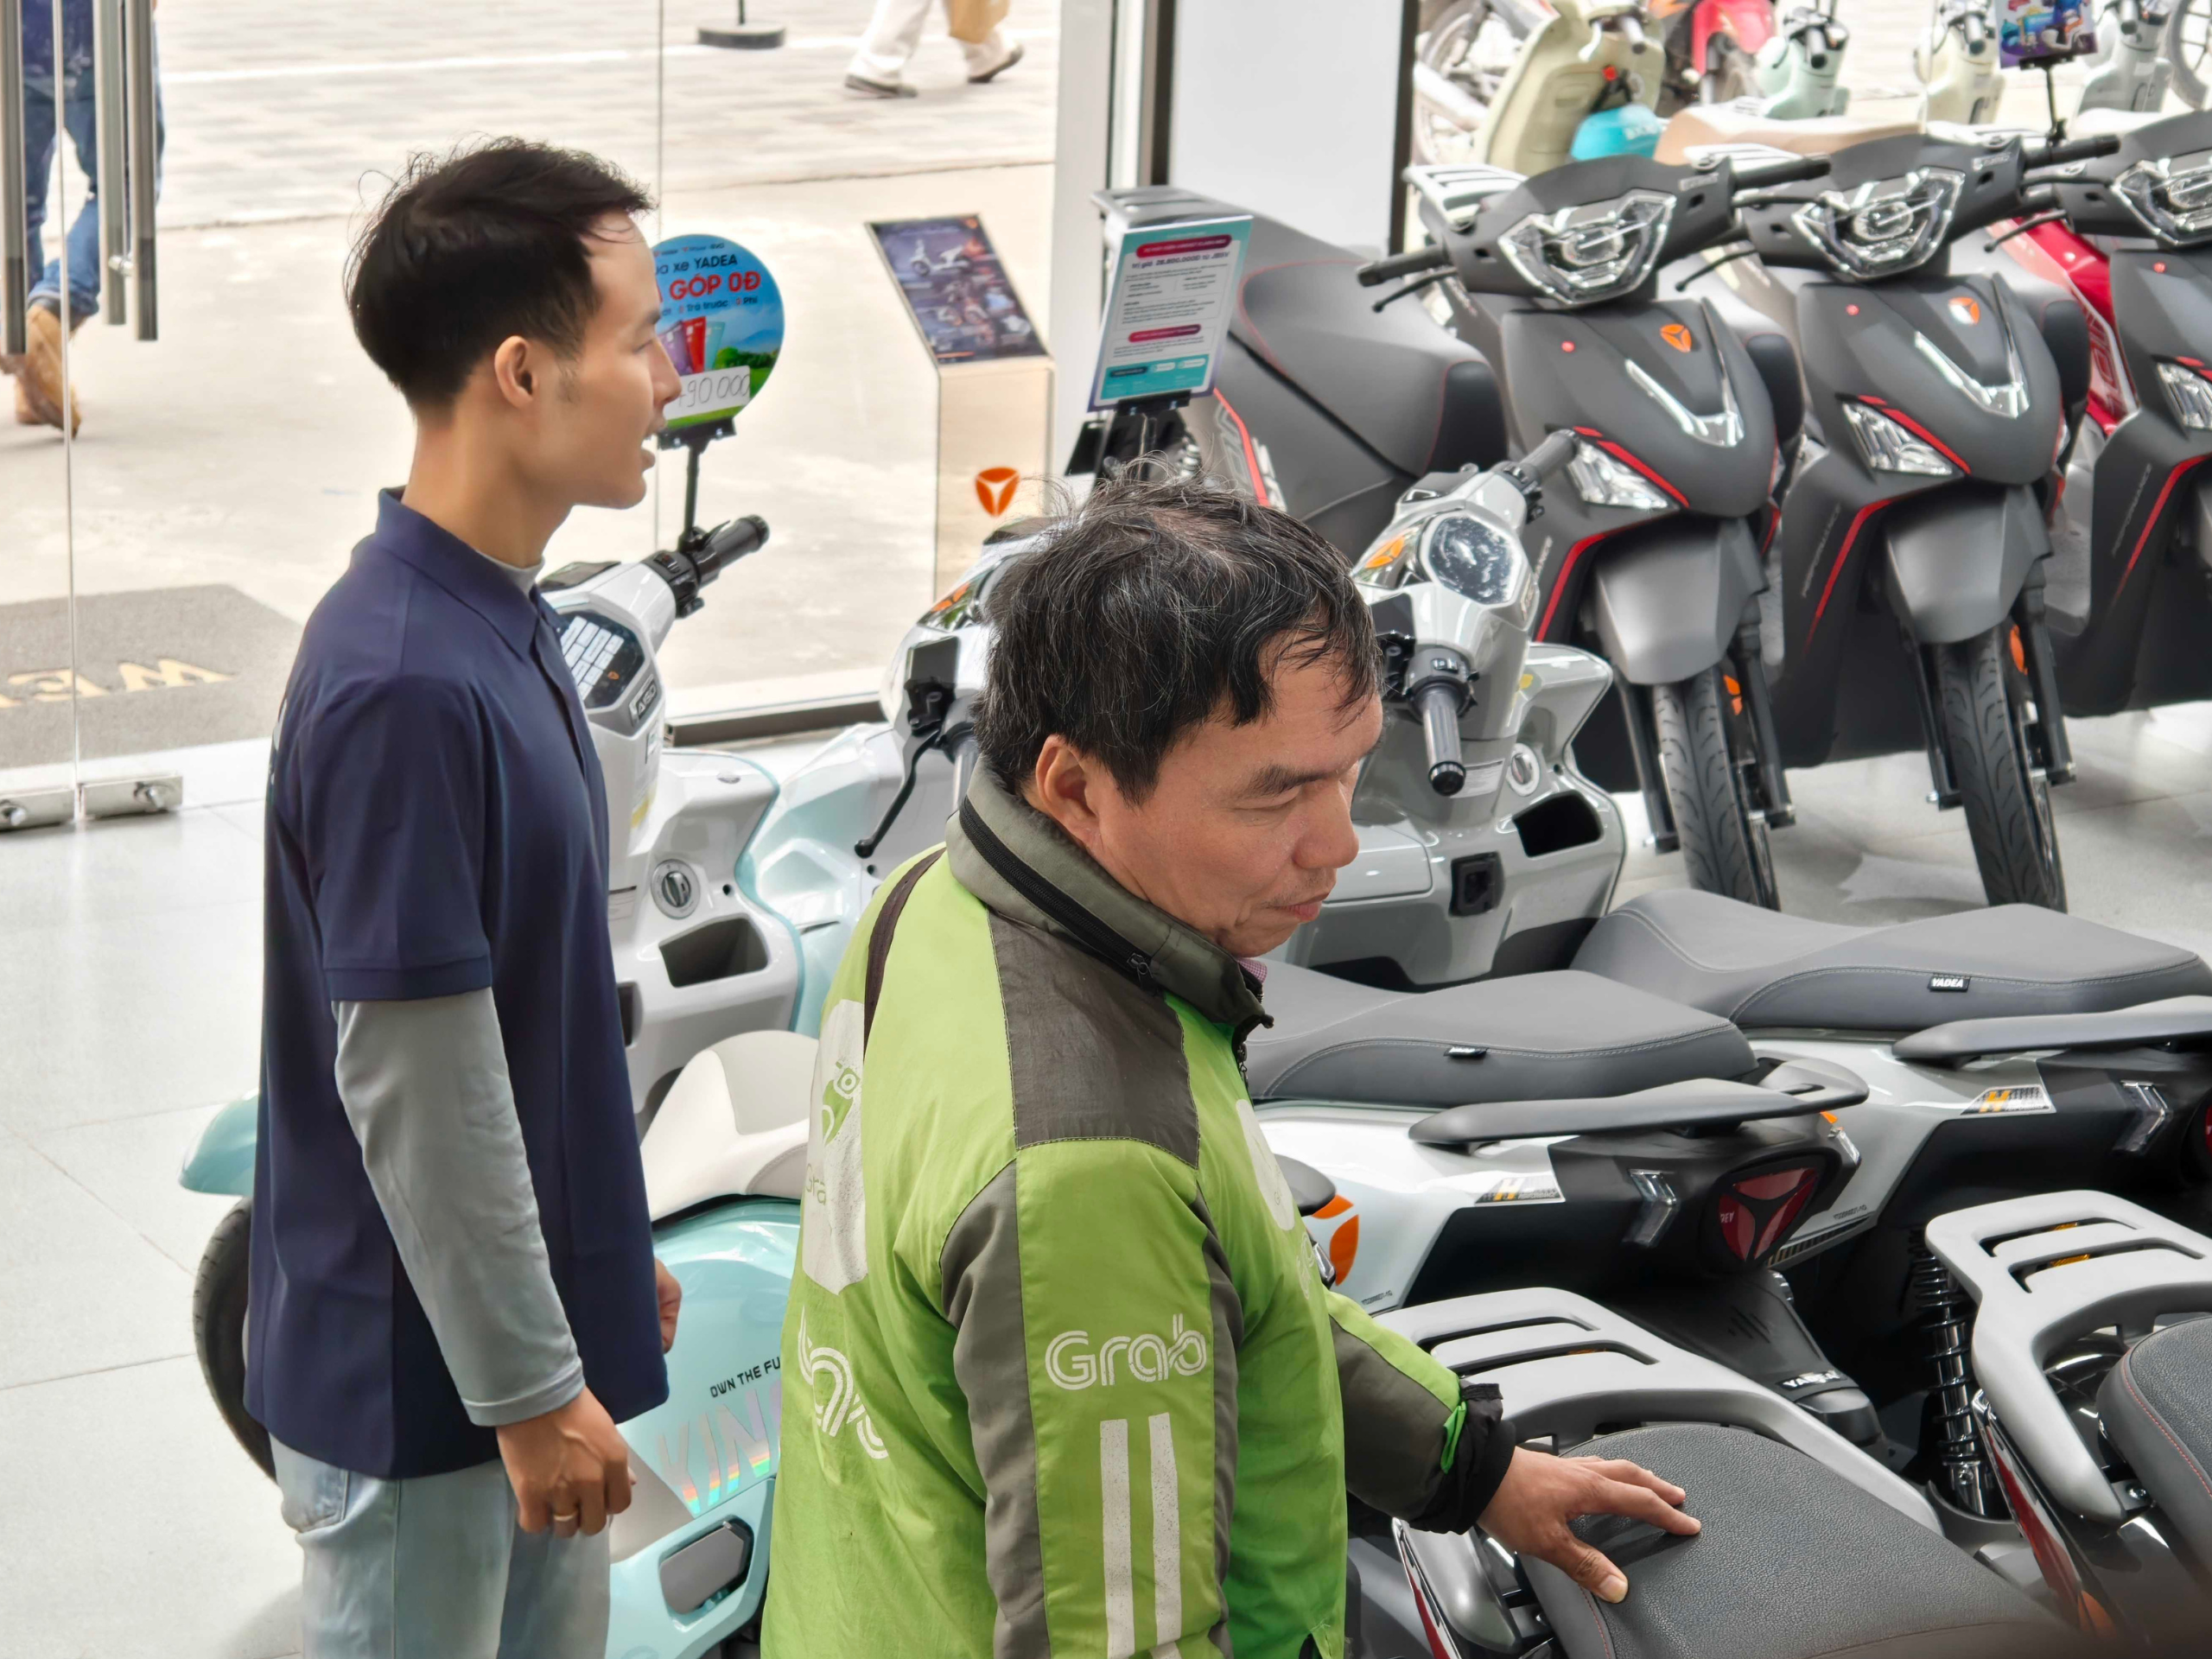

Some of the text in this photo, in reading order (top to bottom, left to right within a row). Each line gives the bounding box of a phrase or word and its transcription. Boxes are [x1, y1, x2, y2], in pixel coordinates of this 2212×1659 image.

[673, 261, 690, 273] xe
[694, 254, 738, 269] YADEA
[670, 273, 722, 301] GÓP
[728, 270, 761, 292] 0Đ
[0, 658, 234, 709] WE
[1931, 977, 1964, 988] YADEA
[1045, 1313, 1207, 1390] Grab
[709, 1356, 781, 1398] OWN THE FU
